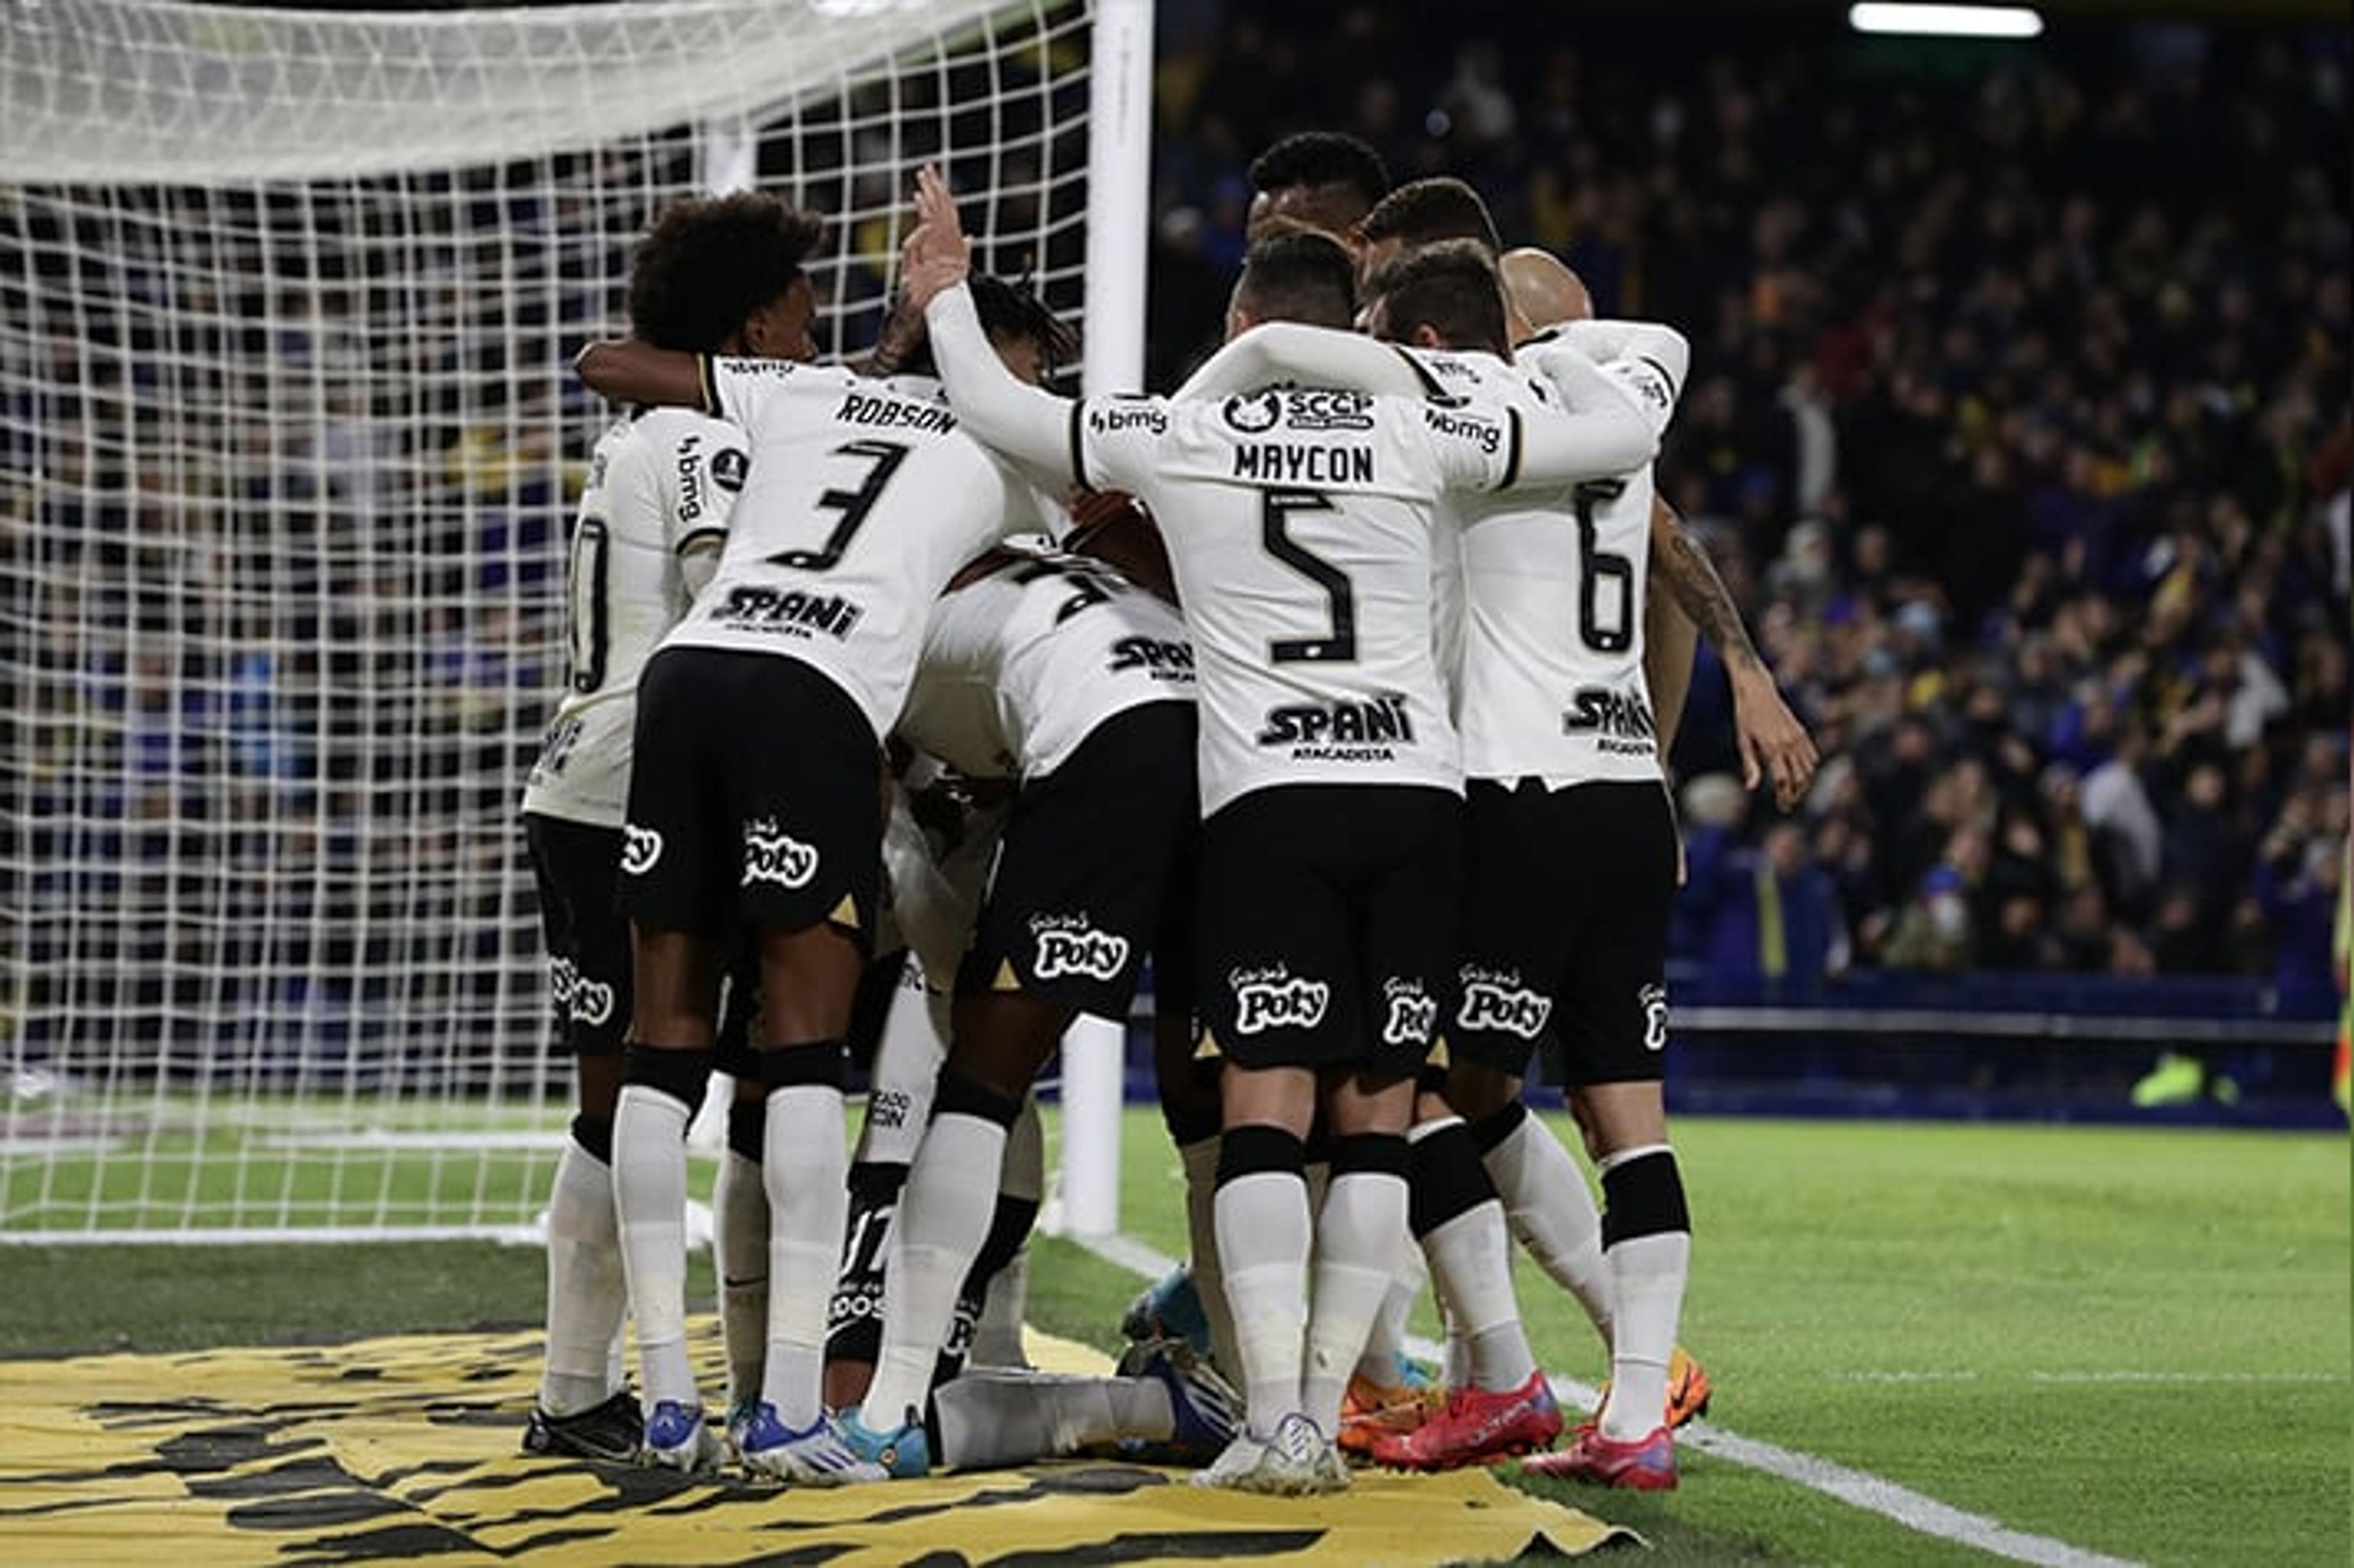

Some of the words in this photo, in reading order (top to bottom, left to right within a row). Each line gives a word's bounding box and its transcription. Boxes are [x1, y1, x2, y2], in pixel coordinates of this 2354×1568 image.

[836, 395, 958, 436] ROBSON
[1108, 408, 1167, 435] bmg
[1440, 412, 1501, 454] bmg
[678, 455, 702, 522] bmg
[1233, 445, 1373, 482] MAYCON
[763, 440, 911, 571] 3
[1264, 489, 1357, 664] 5
[1576, 479, 1633, 652] 6
[1034, 931, 1129, 980] Poty
[1238, 980, 1328, 1033] Poty
[1458, 983, 1552, 1037] Poty
